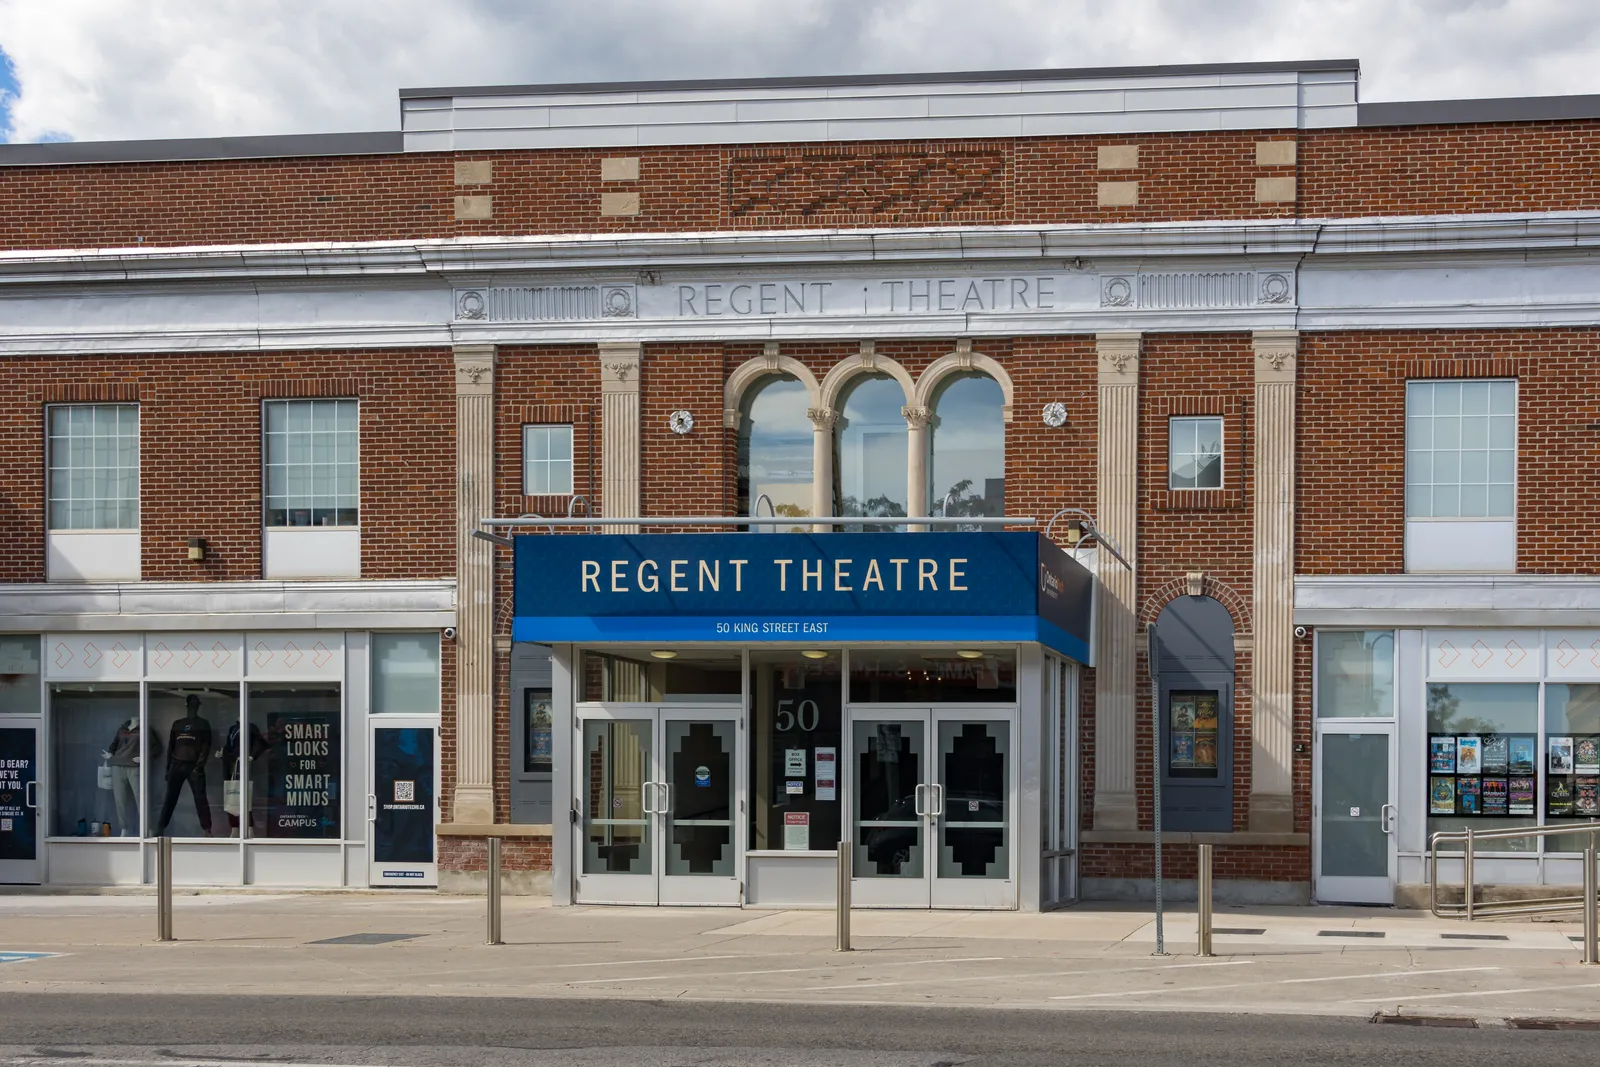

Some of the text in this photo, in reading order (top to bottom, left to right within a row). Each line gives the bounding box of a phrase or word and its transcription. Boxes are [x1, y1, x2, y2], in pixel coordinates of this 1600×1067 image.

[679, 277, 1054, 316] REGENT THEATRE
[581, 558, 968, 593] REGENT THEATRE
[715, 622, 829, 634] 50 KING STREET EAST
[775, 699, 820, 732] 50
[284, 723, 331, 740] SMART
[287, 740, 329, 756] LOOKS
[7, 759, 29, 769] GEAR?
[299, 759, 317, 770] FOR
[7, 781, 23, 790] YOU.
[285, 774, 331, 790] SMART
[286, 790, 330, 806] MINDS
[278, 818, 317, 828] CAMPUS
